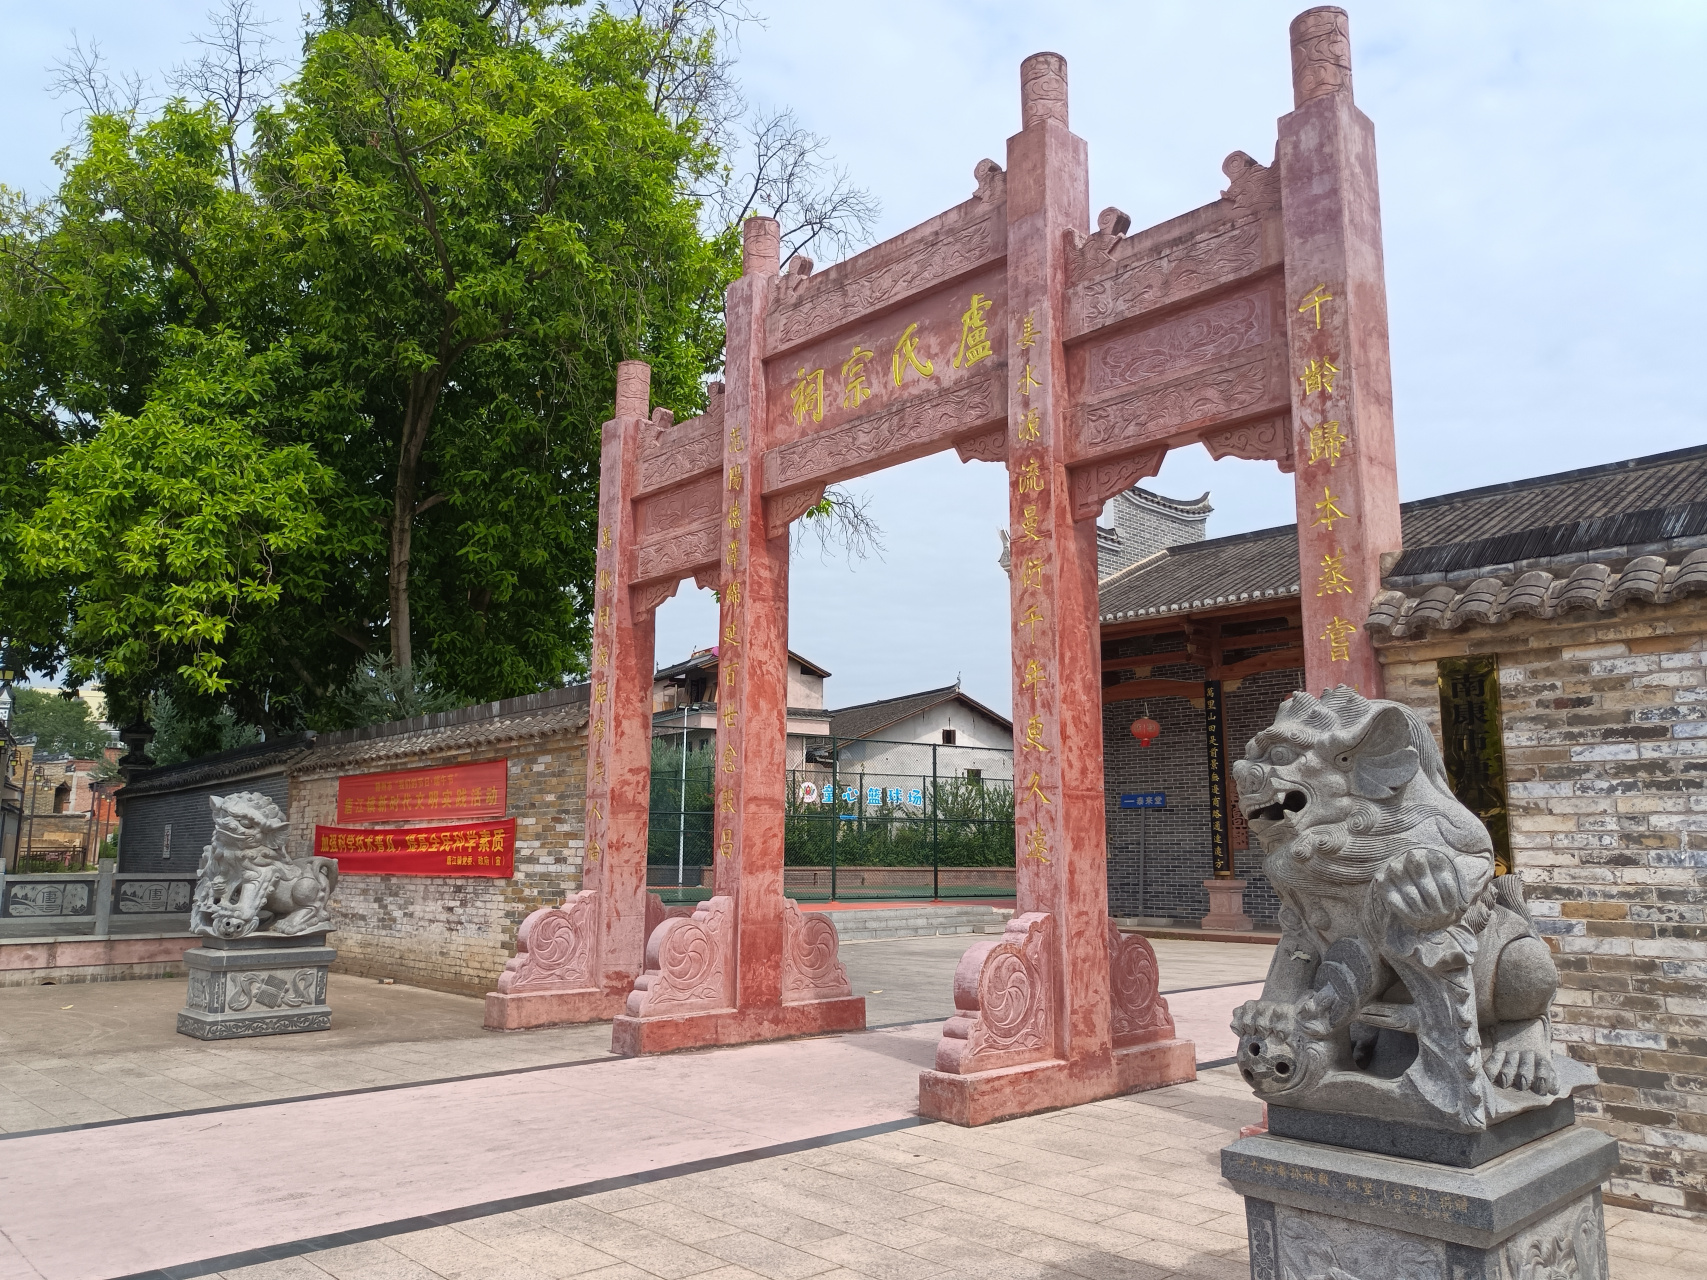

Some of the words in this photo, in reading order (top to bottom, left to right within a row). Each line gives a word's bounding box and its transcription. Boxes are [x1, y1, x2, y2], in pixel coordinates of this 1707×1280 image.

[790, 293, 993, 425] 盧氏宗祠
[1298, 283, 1358, 692] 千齡歸本蒸嘗
[822, 784, 923, 807] 童心篮球场
